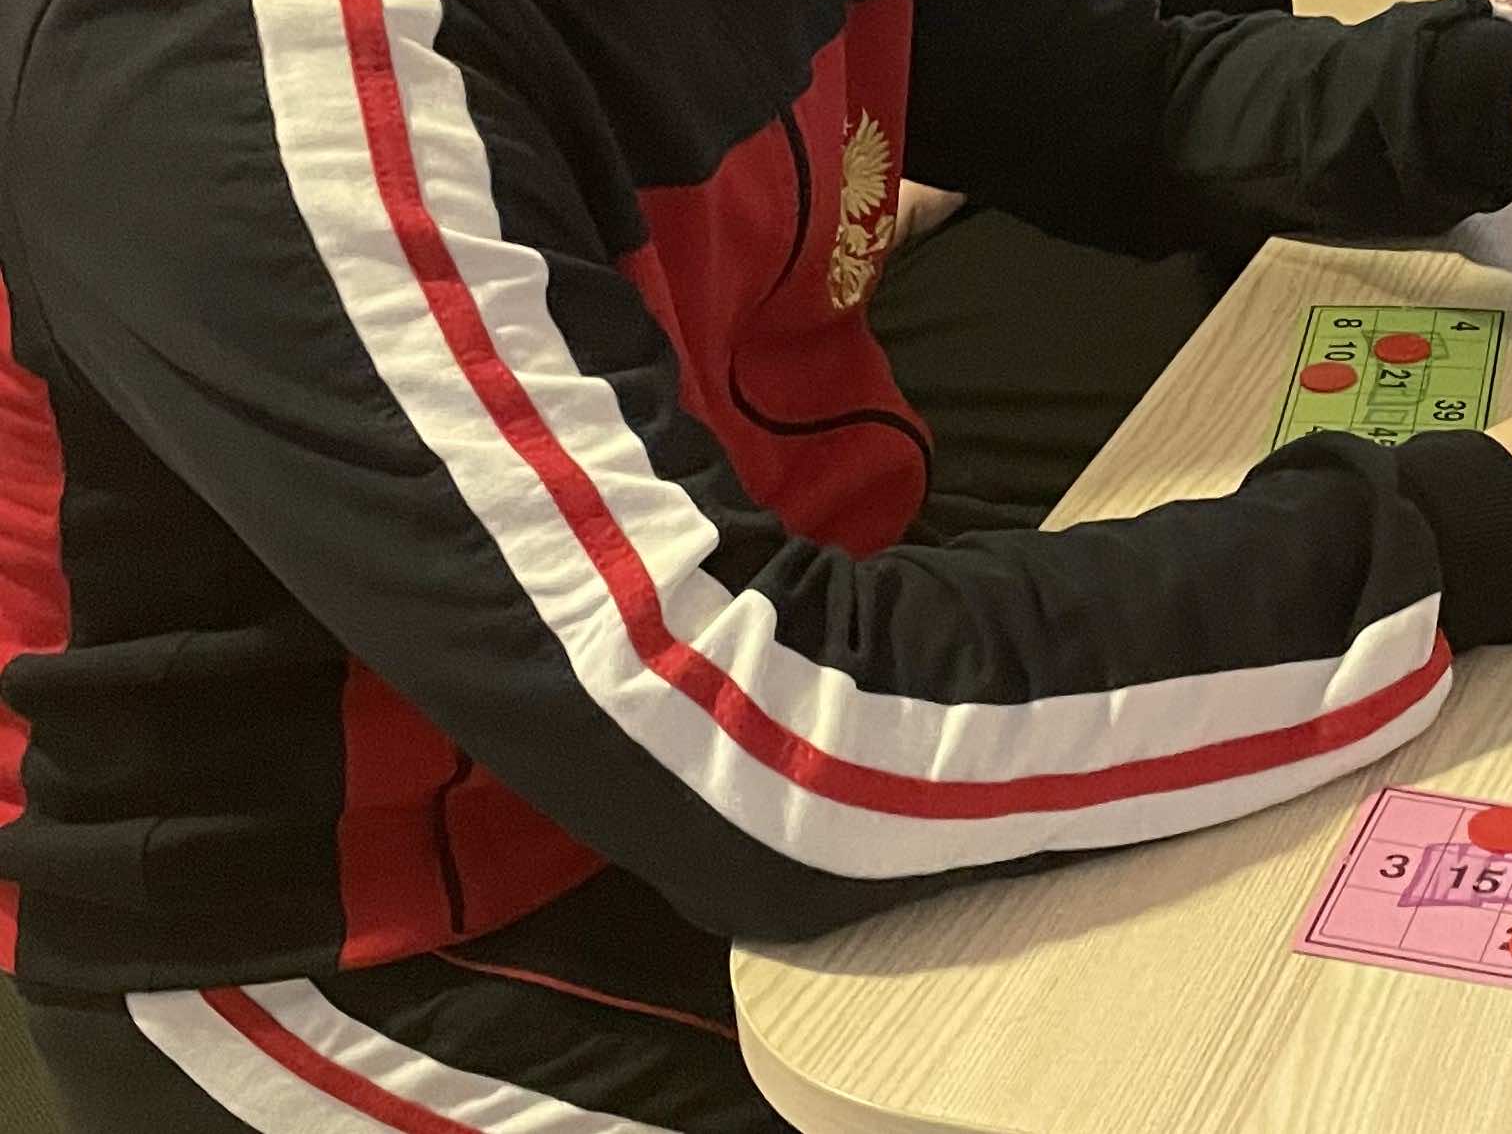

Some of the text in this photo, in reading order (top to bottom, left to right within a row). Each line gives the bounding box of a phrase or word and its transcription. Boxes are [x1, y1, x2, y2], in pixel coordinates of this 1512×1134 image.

[1324, 318, 1363, 362] 8 10
[1379, 369, 1412, 390] 21
[1432, 321, 1480, 422] 4 39
[1379, 853, 1410, 879] 3
[1449, 865, 1503, 894] 15
